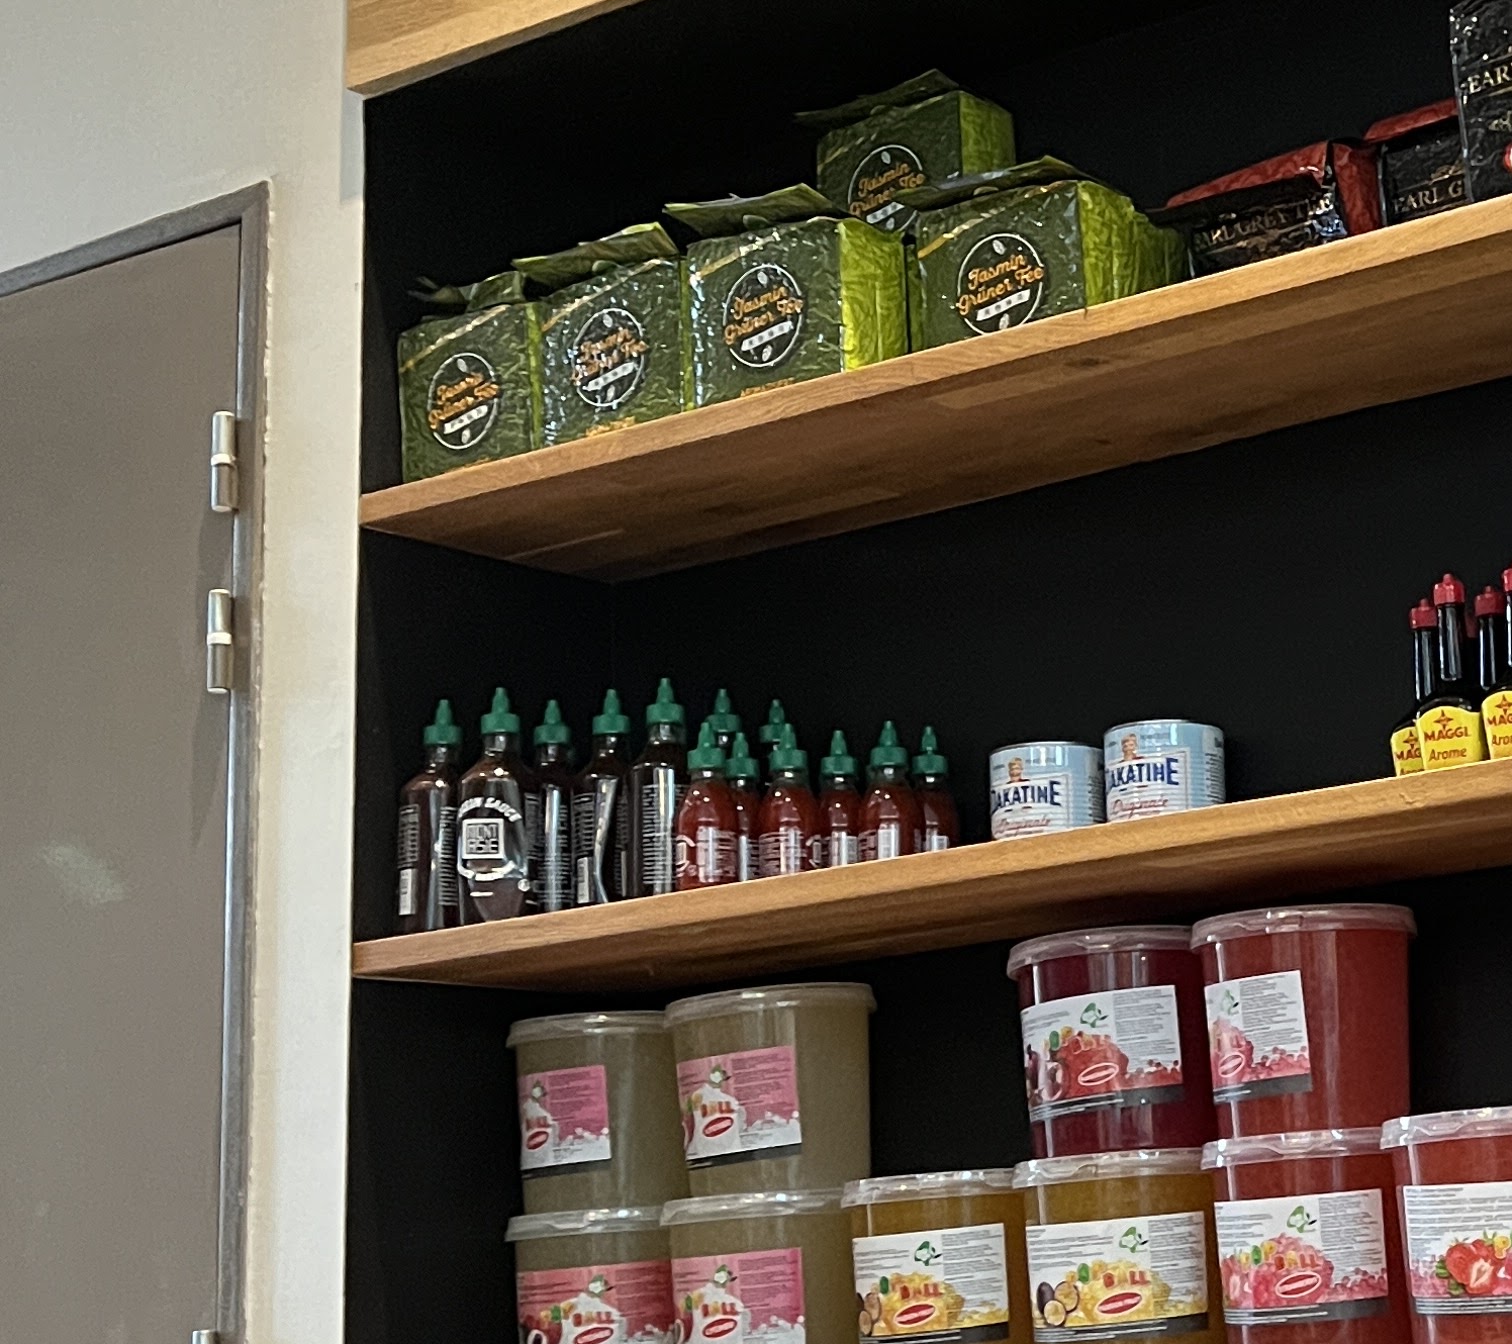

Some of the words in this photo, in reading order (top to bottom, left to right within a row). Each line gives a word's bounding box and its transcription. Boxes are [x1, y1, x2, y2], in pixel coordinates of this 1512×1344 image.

[968, 254, 1025, 290] Jasmin
[1424, 727, 1470, 742] MAGGI
[1395, 747, 1421, 761] MAG
[1428, 747, 1467, 761] Arome
[1105, 757, 1179, 791] AKATINE
